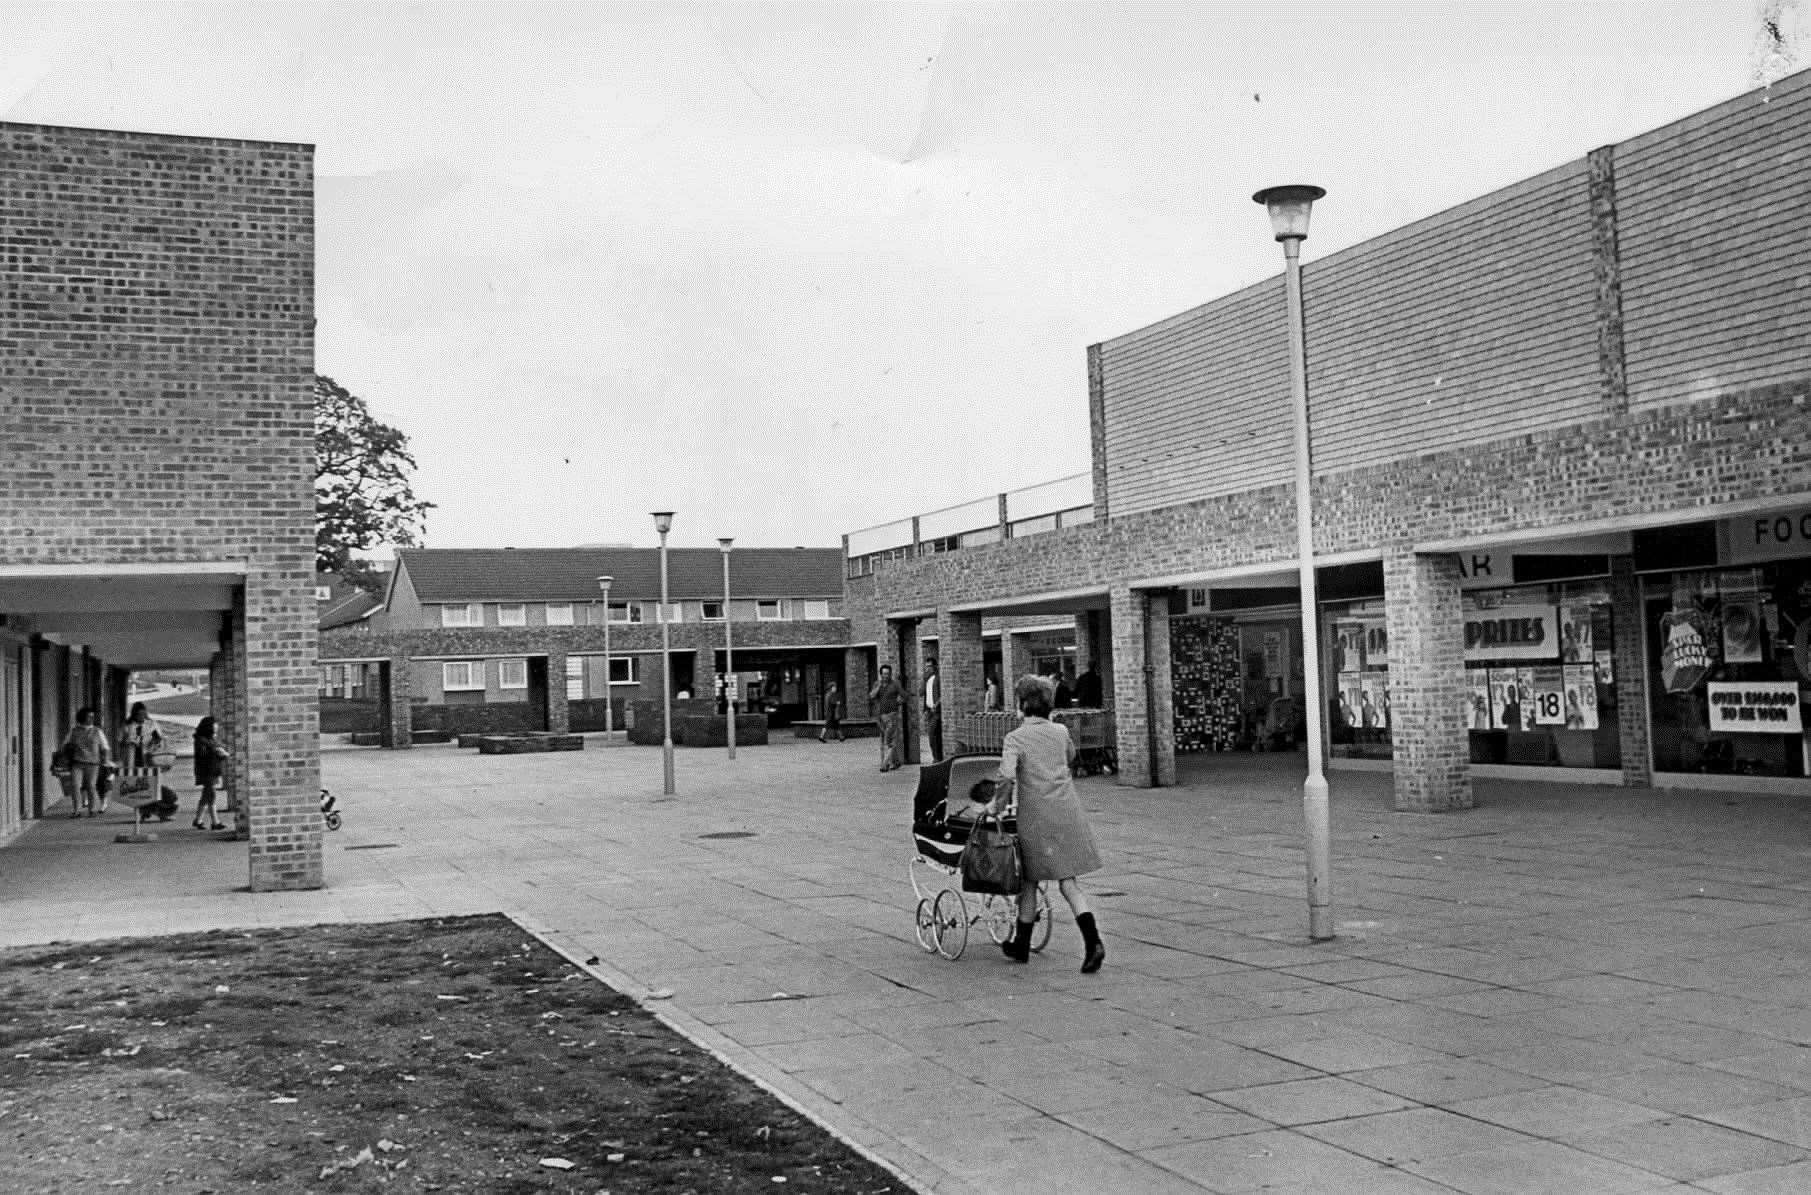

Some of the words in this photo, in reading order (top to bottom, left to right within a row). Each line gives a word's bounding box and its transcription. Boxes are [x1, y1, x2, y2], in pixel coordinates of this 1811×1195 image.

[1464, 617, 1545, 650] PRIZES
[1537, 692, 1560, 718] 18
[1711, 692, 1743, 707] OVER
[1721, 706, 1737, 721] TO
[1757, 706, 1788, 721] WON
